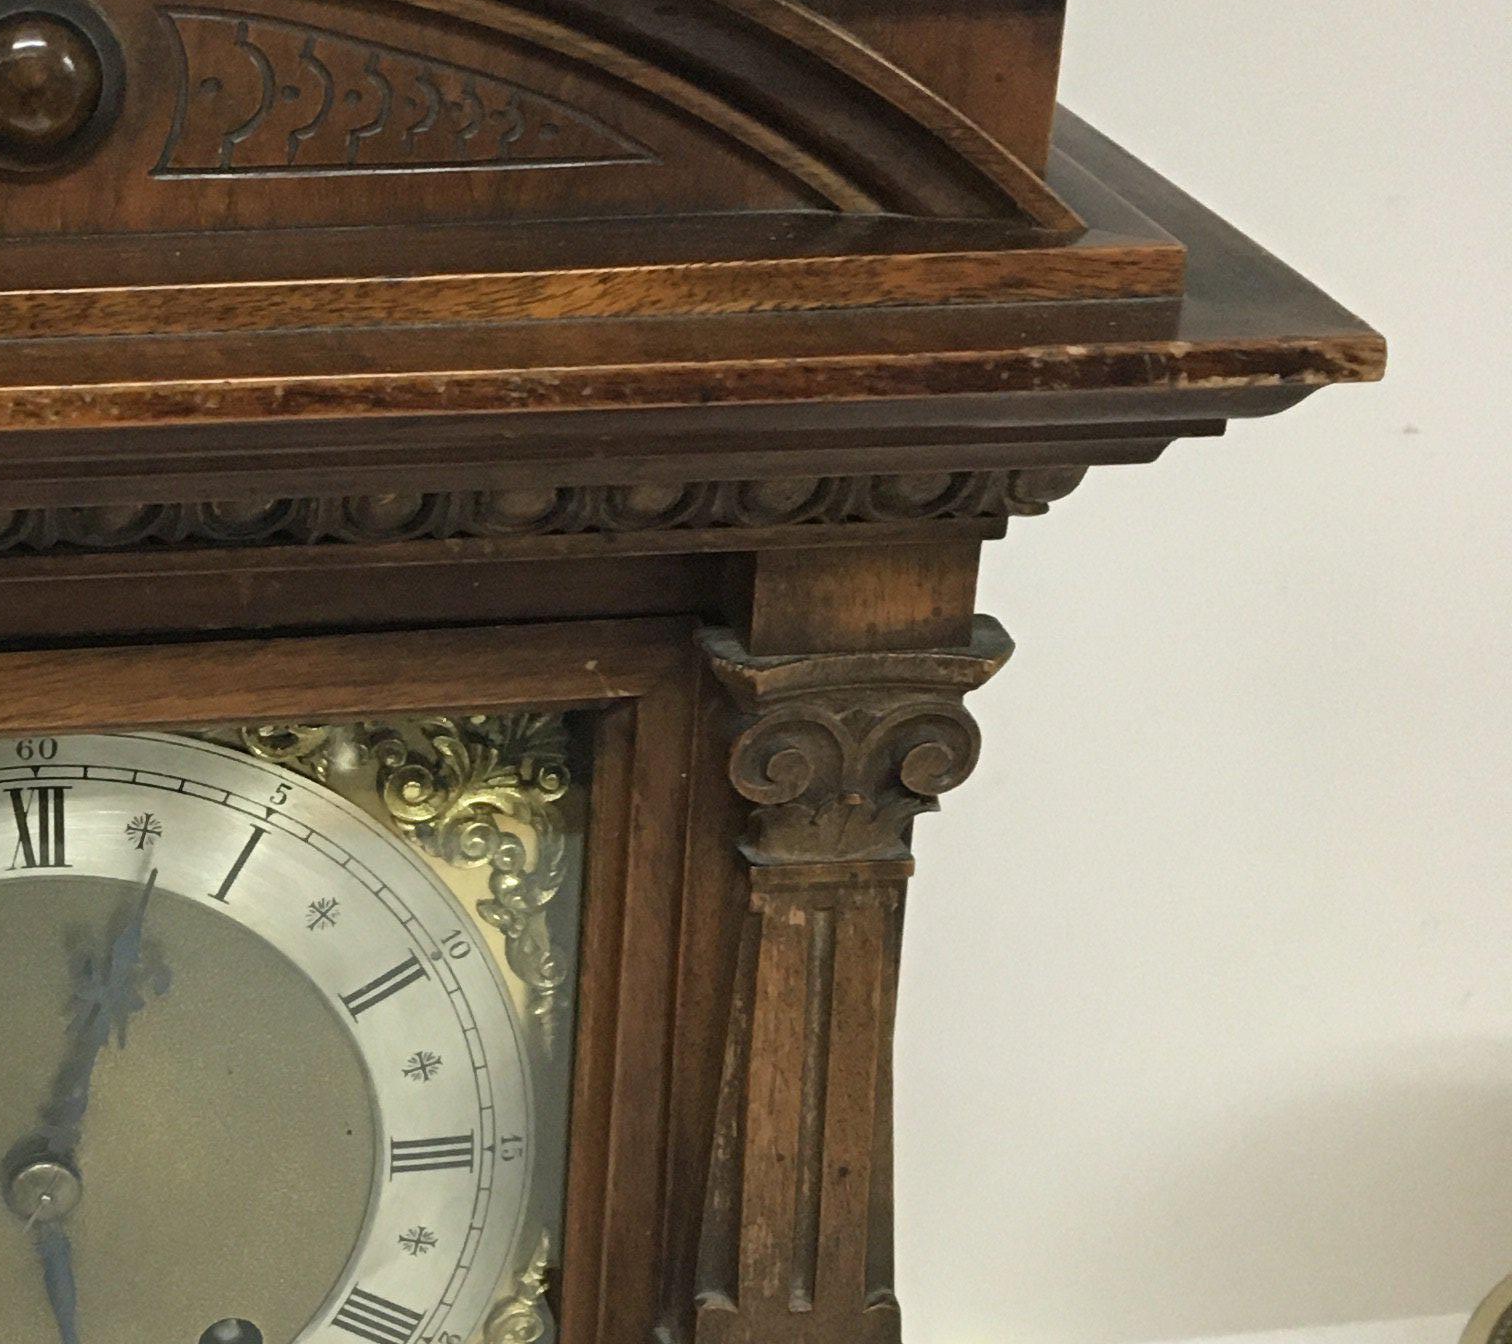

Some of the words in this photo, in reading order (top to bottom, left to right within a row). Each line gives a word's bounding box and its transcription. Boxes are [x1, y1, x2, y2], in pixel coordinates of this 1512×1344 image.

[16, 737, 59, 761] 60
[269, 783, 294, 807] 5
[3, 786, 73, 871] XII
[208, 824, 271, 904] I
[440, 928, 472, 962] 10
[338, 948, 431, 1023] II
[390, 1129, 474, 1181] III
[500, 1134, 524, 1162] 15
